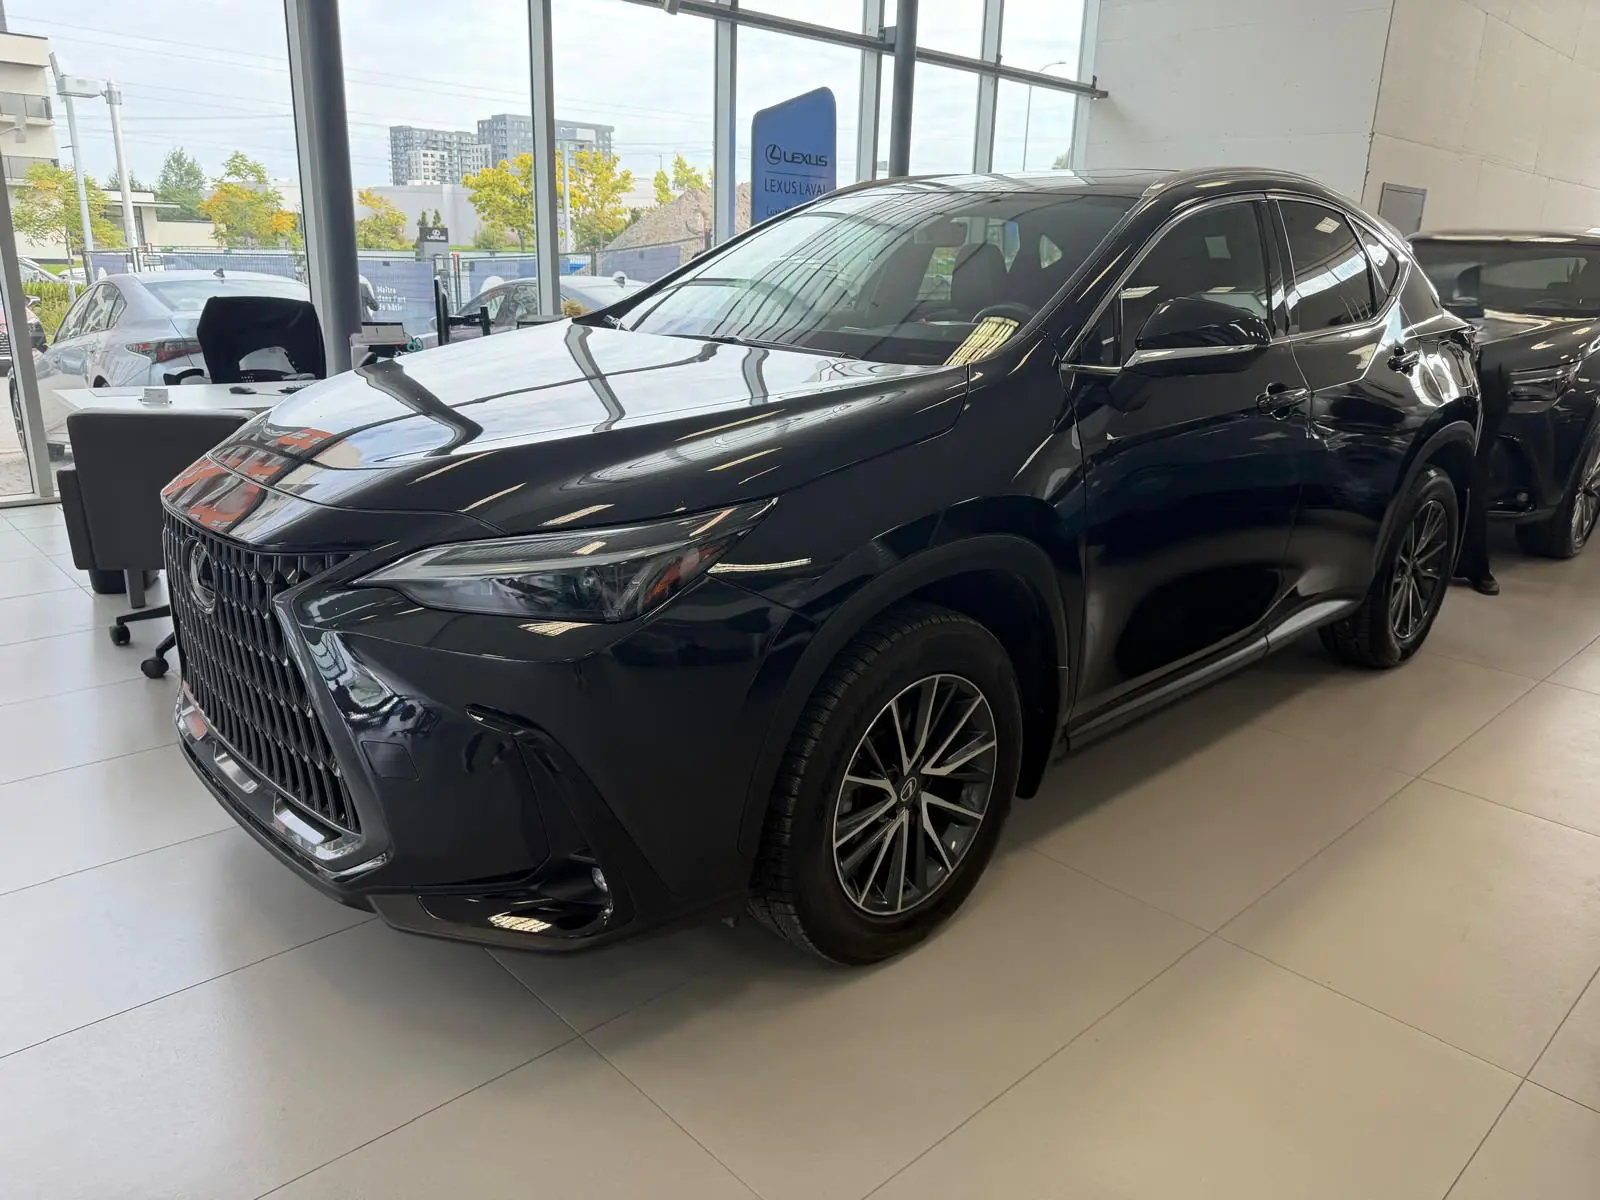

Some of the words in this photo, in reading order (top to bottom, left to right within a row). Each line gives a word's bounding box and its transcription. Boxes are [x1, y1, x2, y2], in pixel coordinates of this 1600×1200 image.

[783, 151, 829, 167] LEXUS
[764, 177, 797, 195] LEXUS
[799, 182, 828, 197] LAVAL
